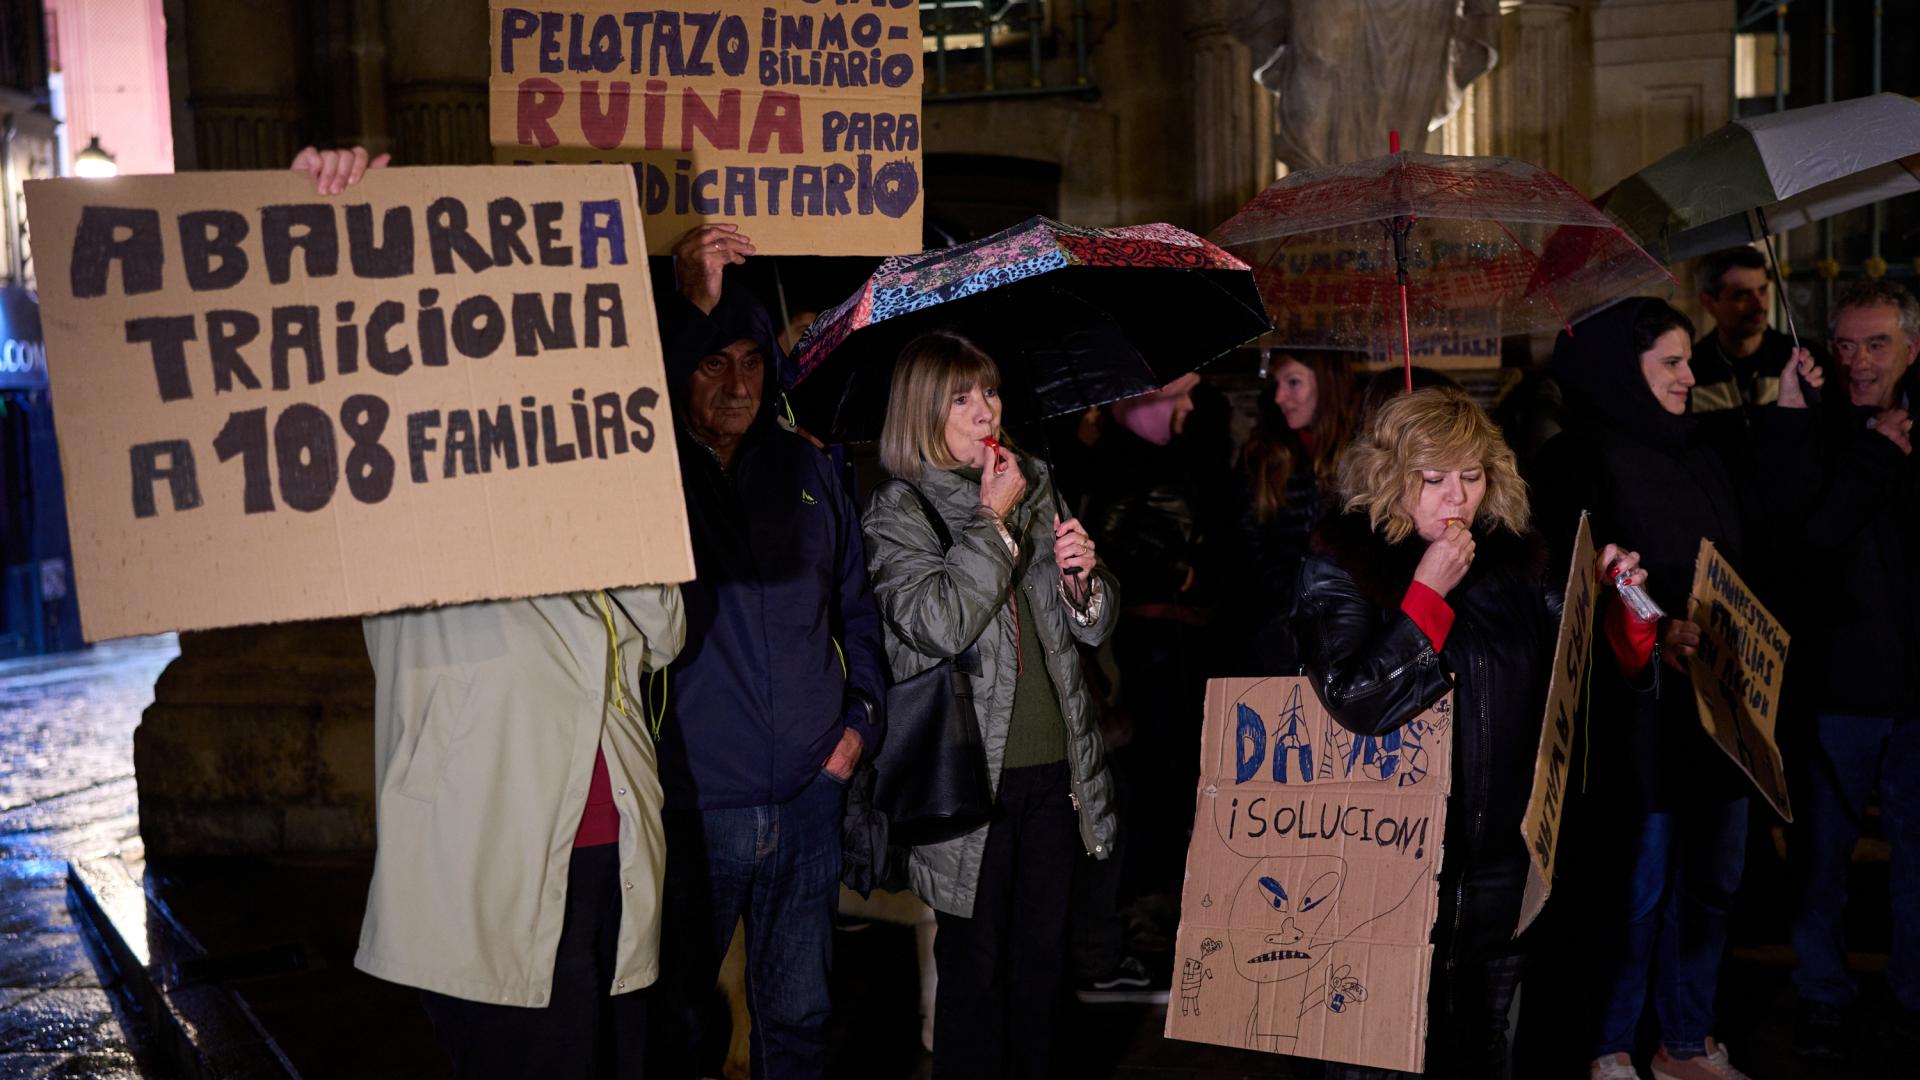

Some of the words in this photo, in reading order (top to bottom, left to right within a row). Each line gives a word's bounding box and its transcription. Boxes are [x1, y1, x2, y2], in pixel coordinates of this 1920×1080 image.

[501, 8, 750, 77] PELOTAZO
[516, 77, 804, 154] RUINA
[821, 110, 920, 152] PARA
[70, 196, 628, 298] ABAURREA
[124, 283, 629, 402] TRAICIONA
[129, 438, 203, 518] A
[212, 393, 396, 514] 108
[406, 386, 660, 483] FAMILIAS
